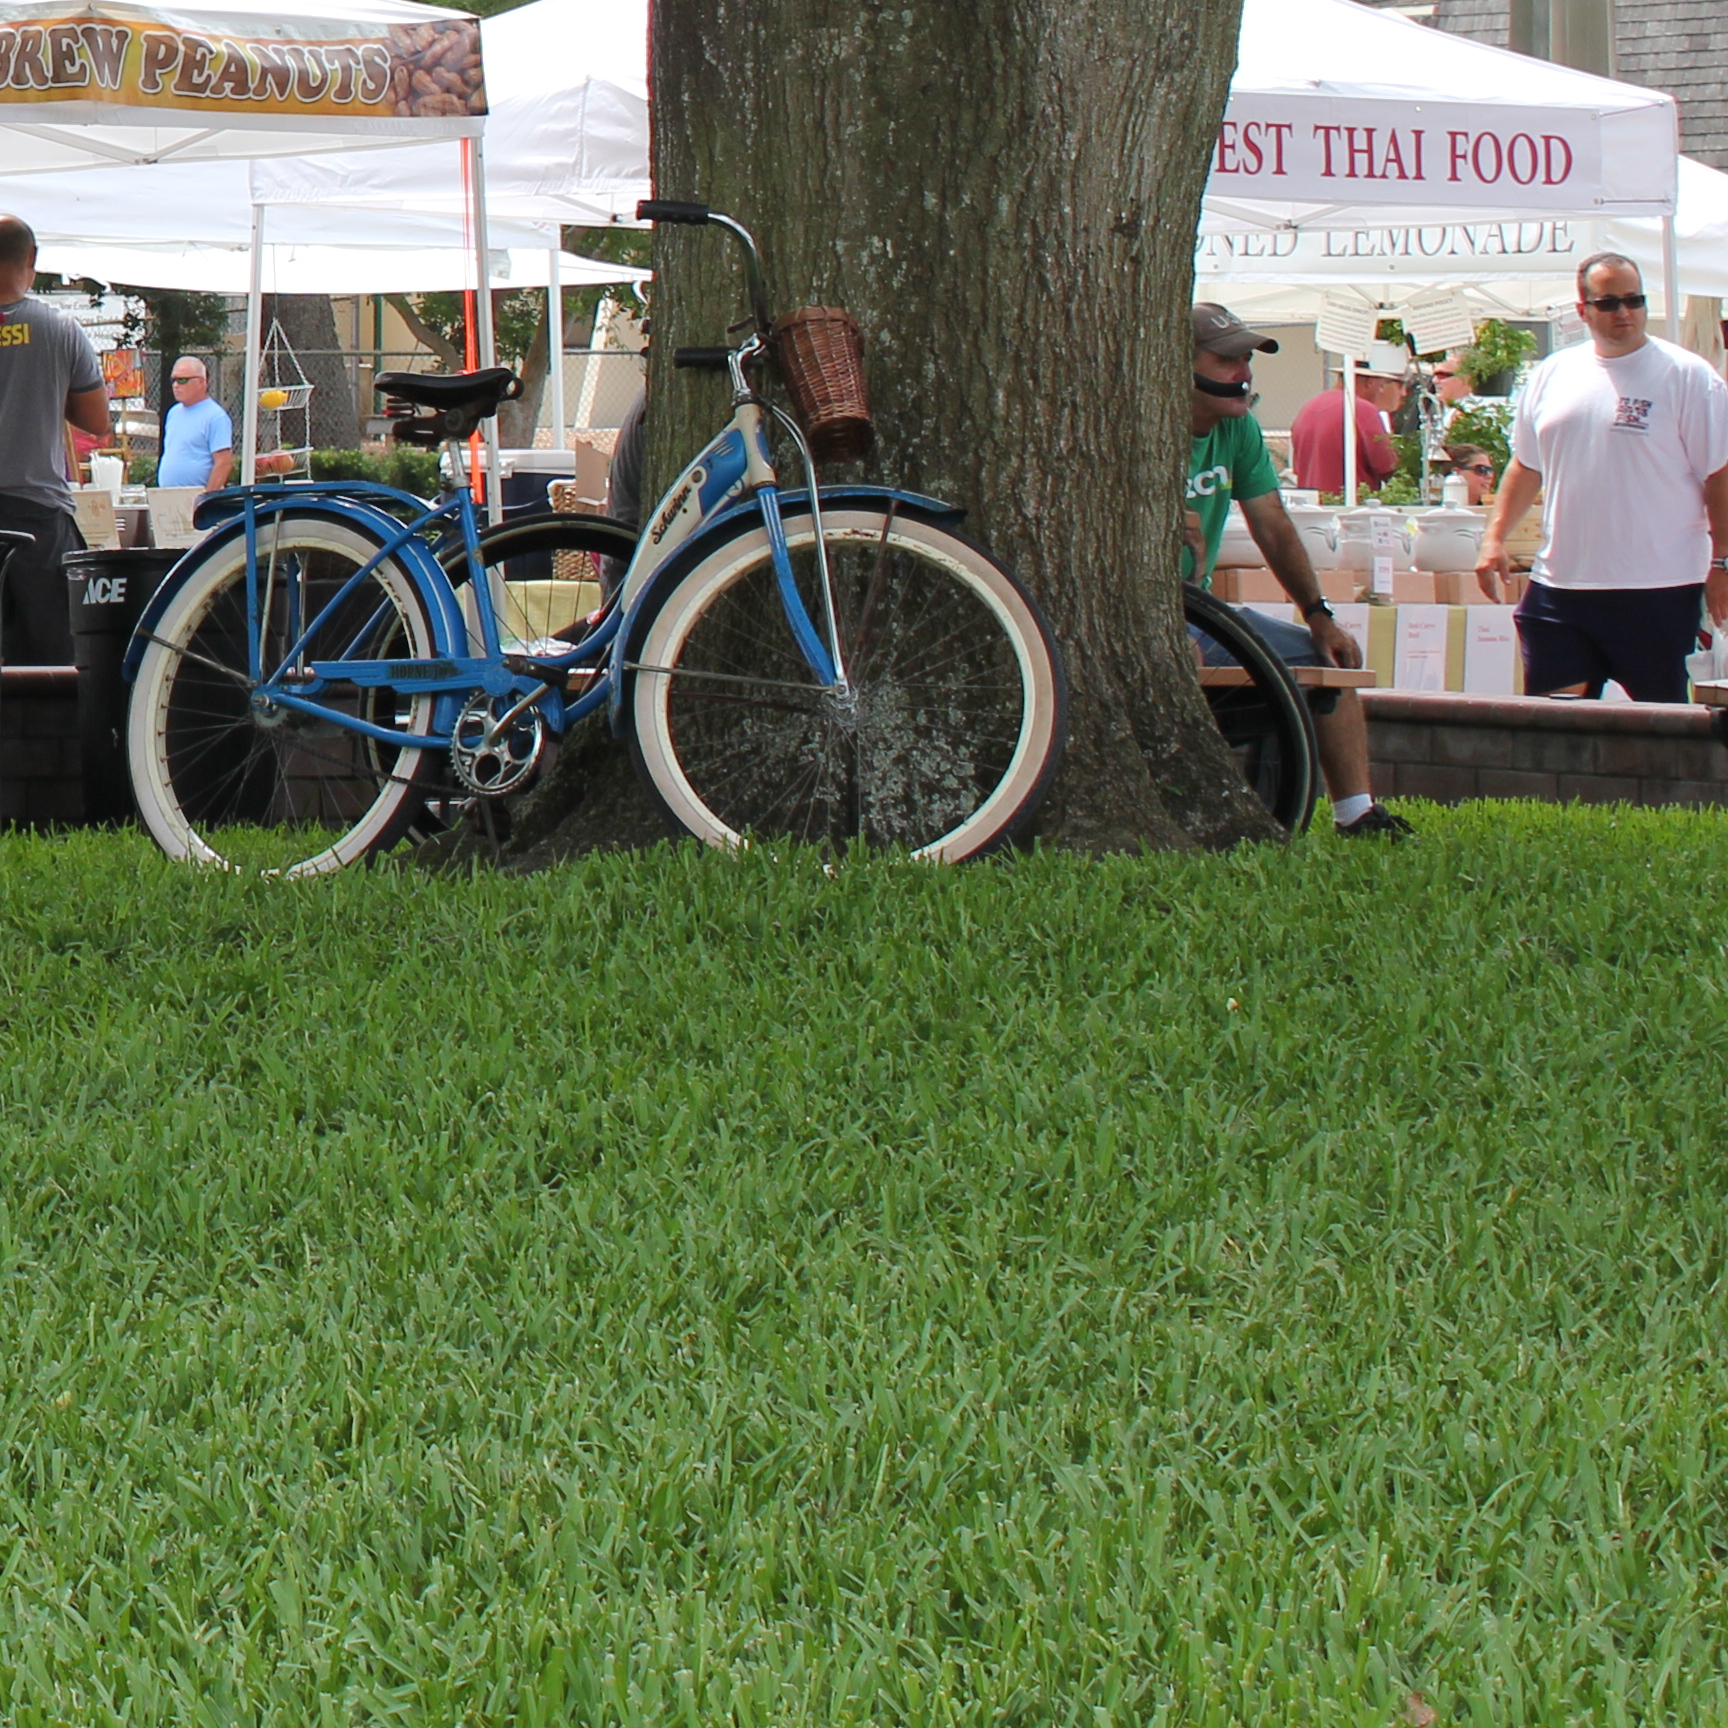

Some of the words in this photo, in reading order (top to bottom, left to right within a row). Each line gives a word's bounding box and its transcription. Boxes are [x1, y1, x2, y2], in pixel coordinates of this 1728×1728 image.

[139, 31, 392, 103] PEANUTS
[1215, 122, 1293, 176] EST
[1313, 125, 1427, 181] THAI
[1446, 130, 1573, 186] FOOD
[1194, 233, 1298, 257] NED
[651, 486, 691, 545] Schwinn
[83, 577, 127, 605] ACE
